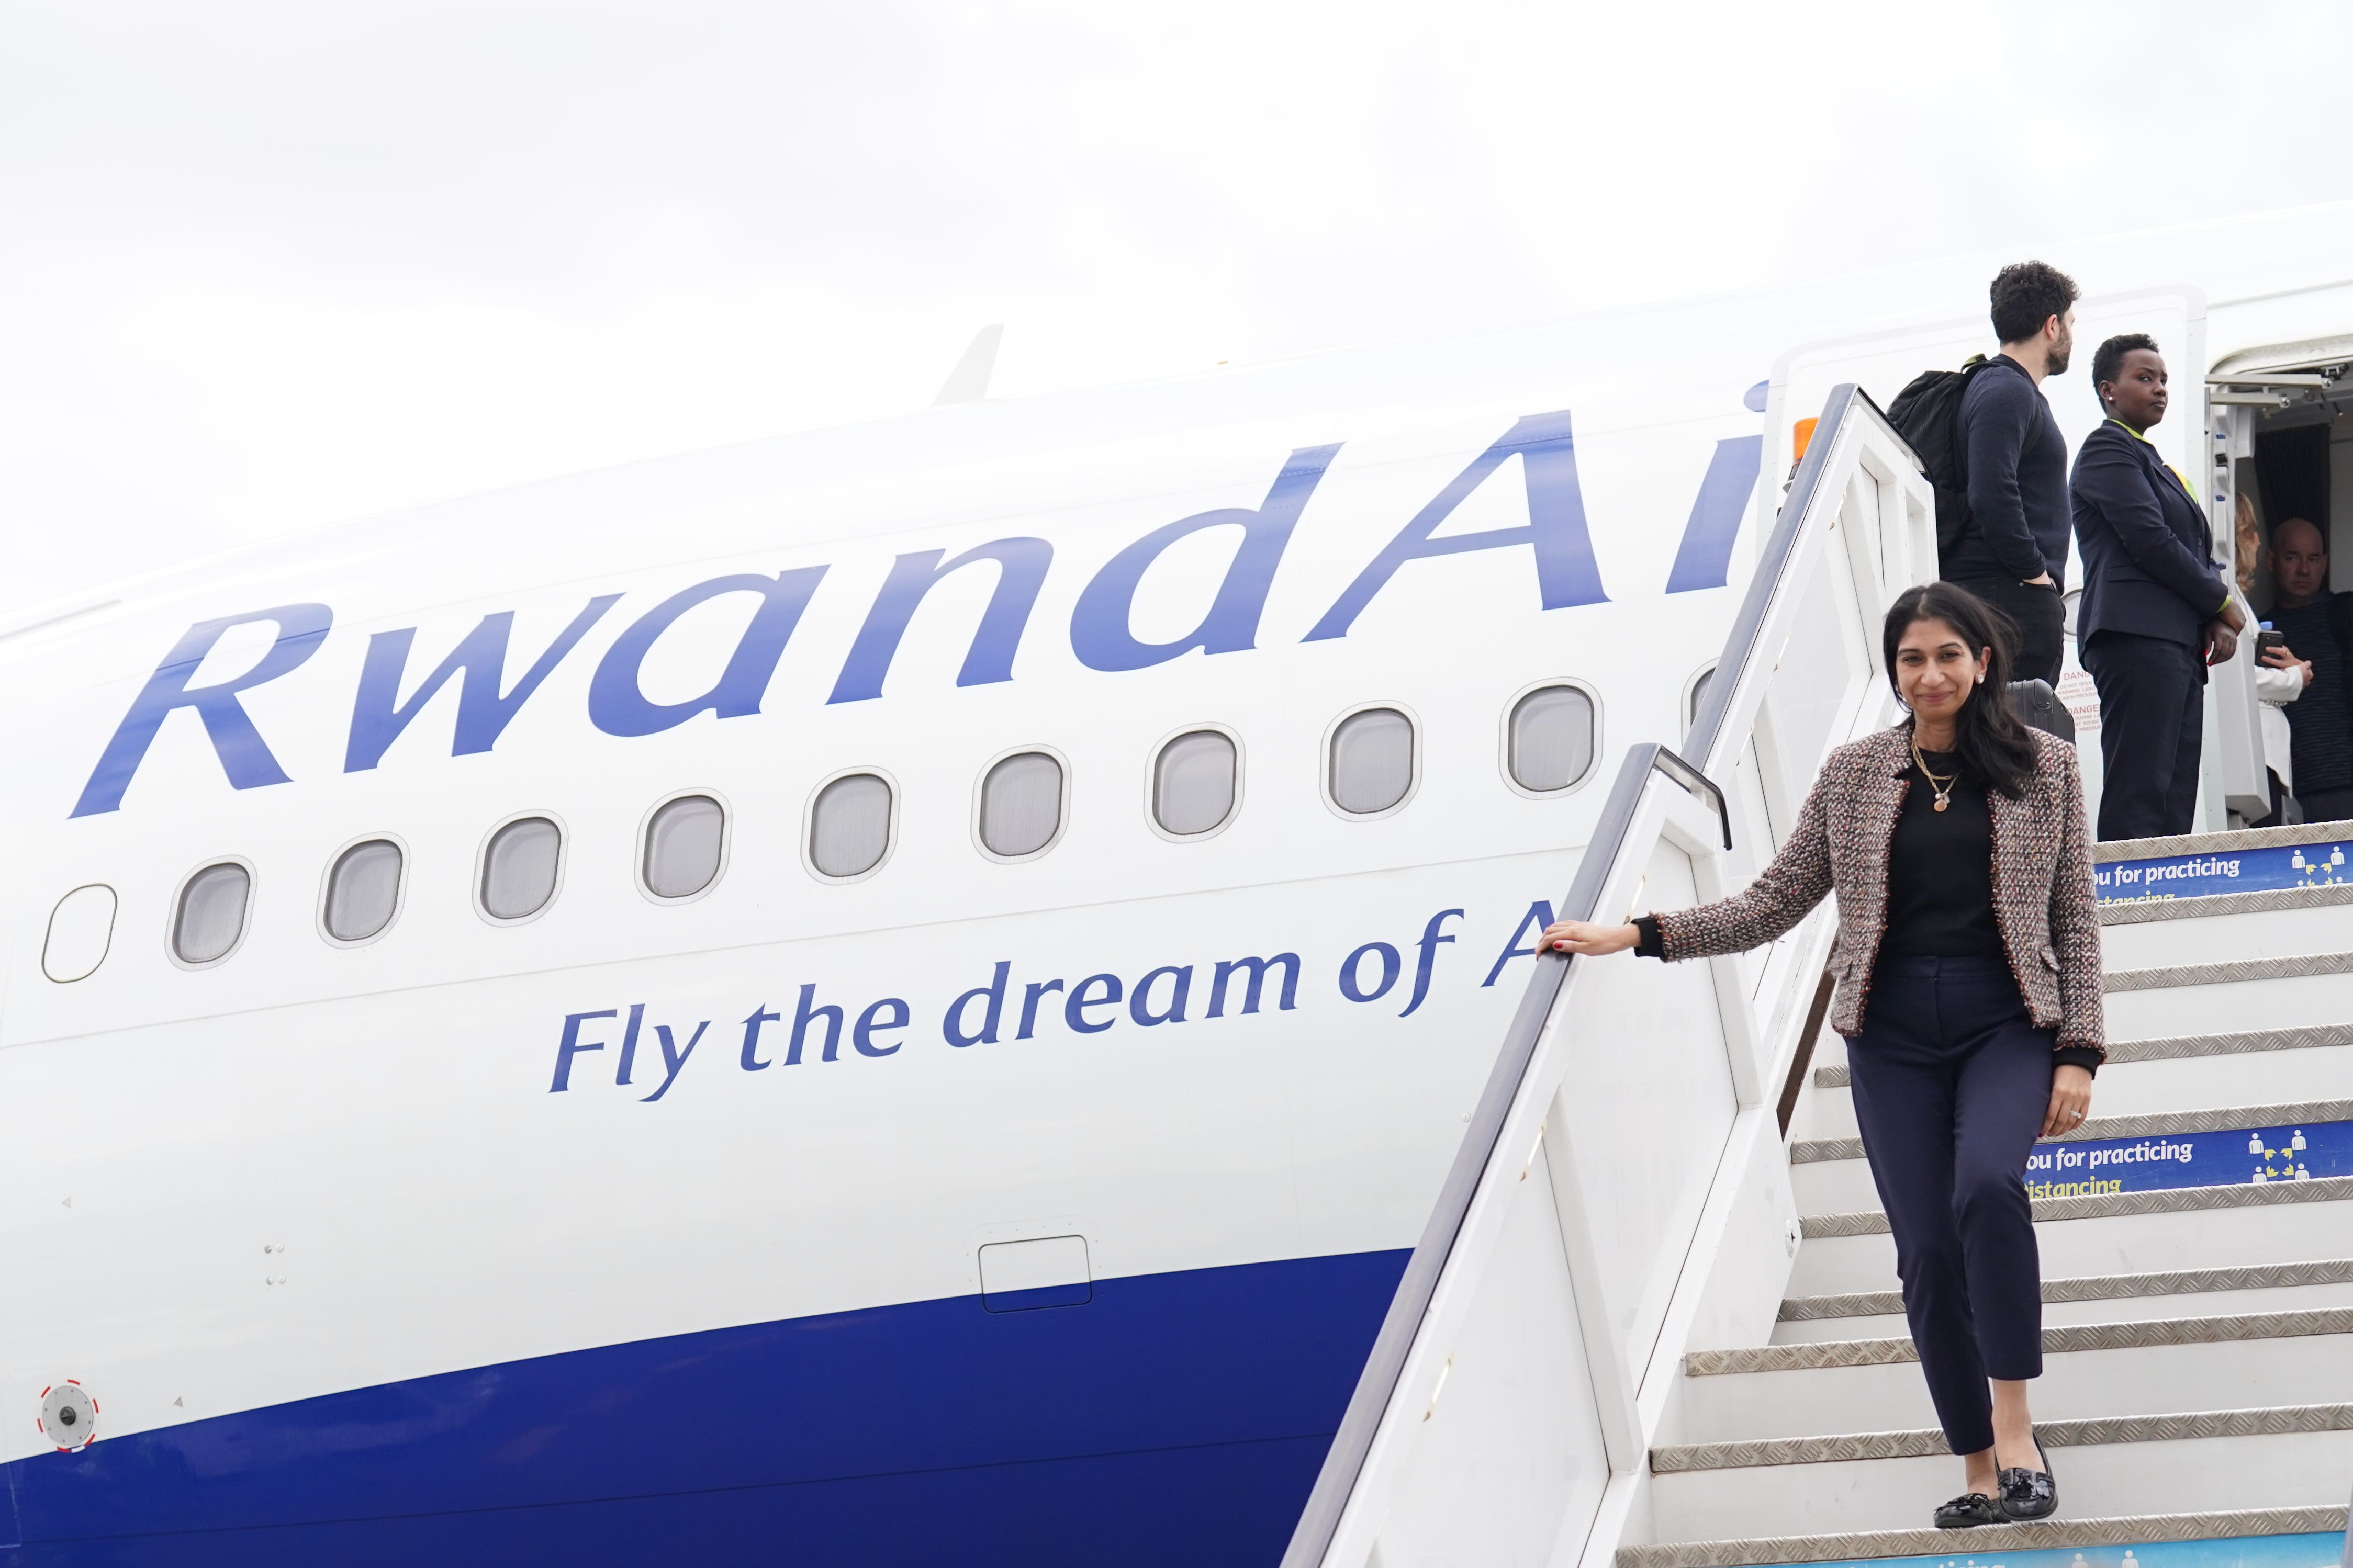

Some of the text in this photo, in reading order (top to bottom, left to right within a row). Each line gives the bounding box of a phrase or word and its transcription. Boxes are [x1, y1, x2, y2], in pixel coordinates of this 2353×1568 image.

[66, 380, 1769, 820] RwandAi
[2068, 704, 2099, 714] DANGE
[2093, 856, 2240, 887] ou for practicing
[550, 900, 1555, 1102] Fly the dream of A
[2026, 1140, 2193, 1171] ou for practicing
